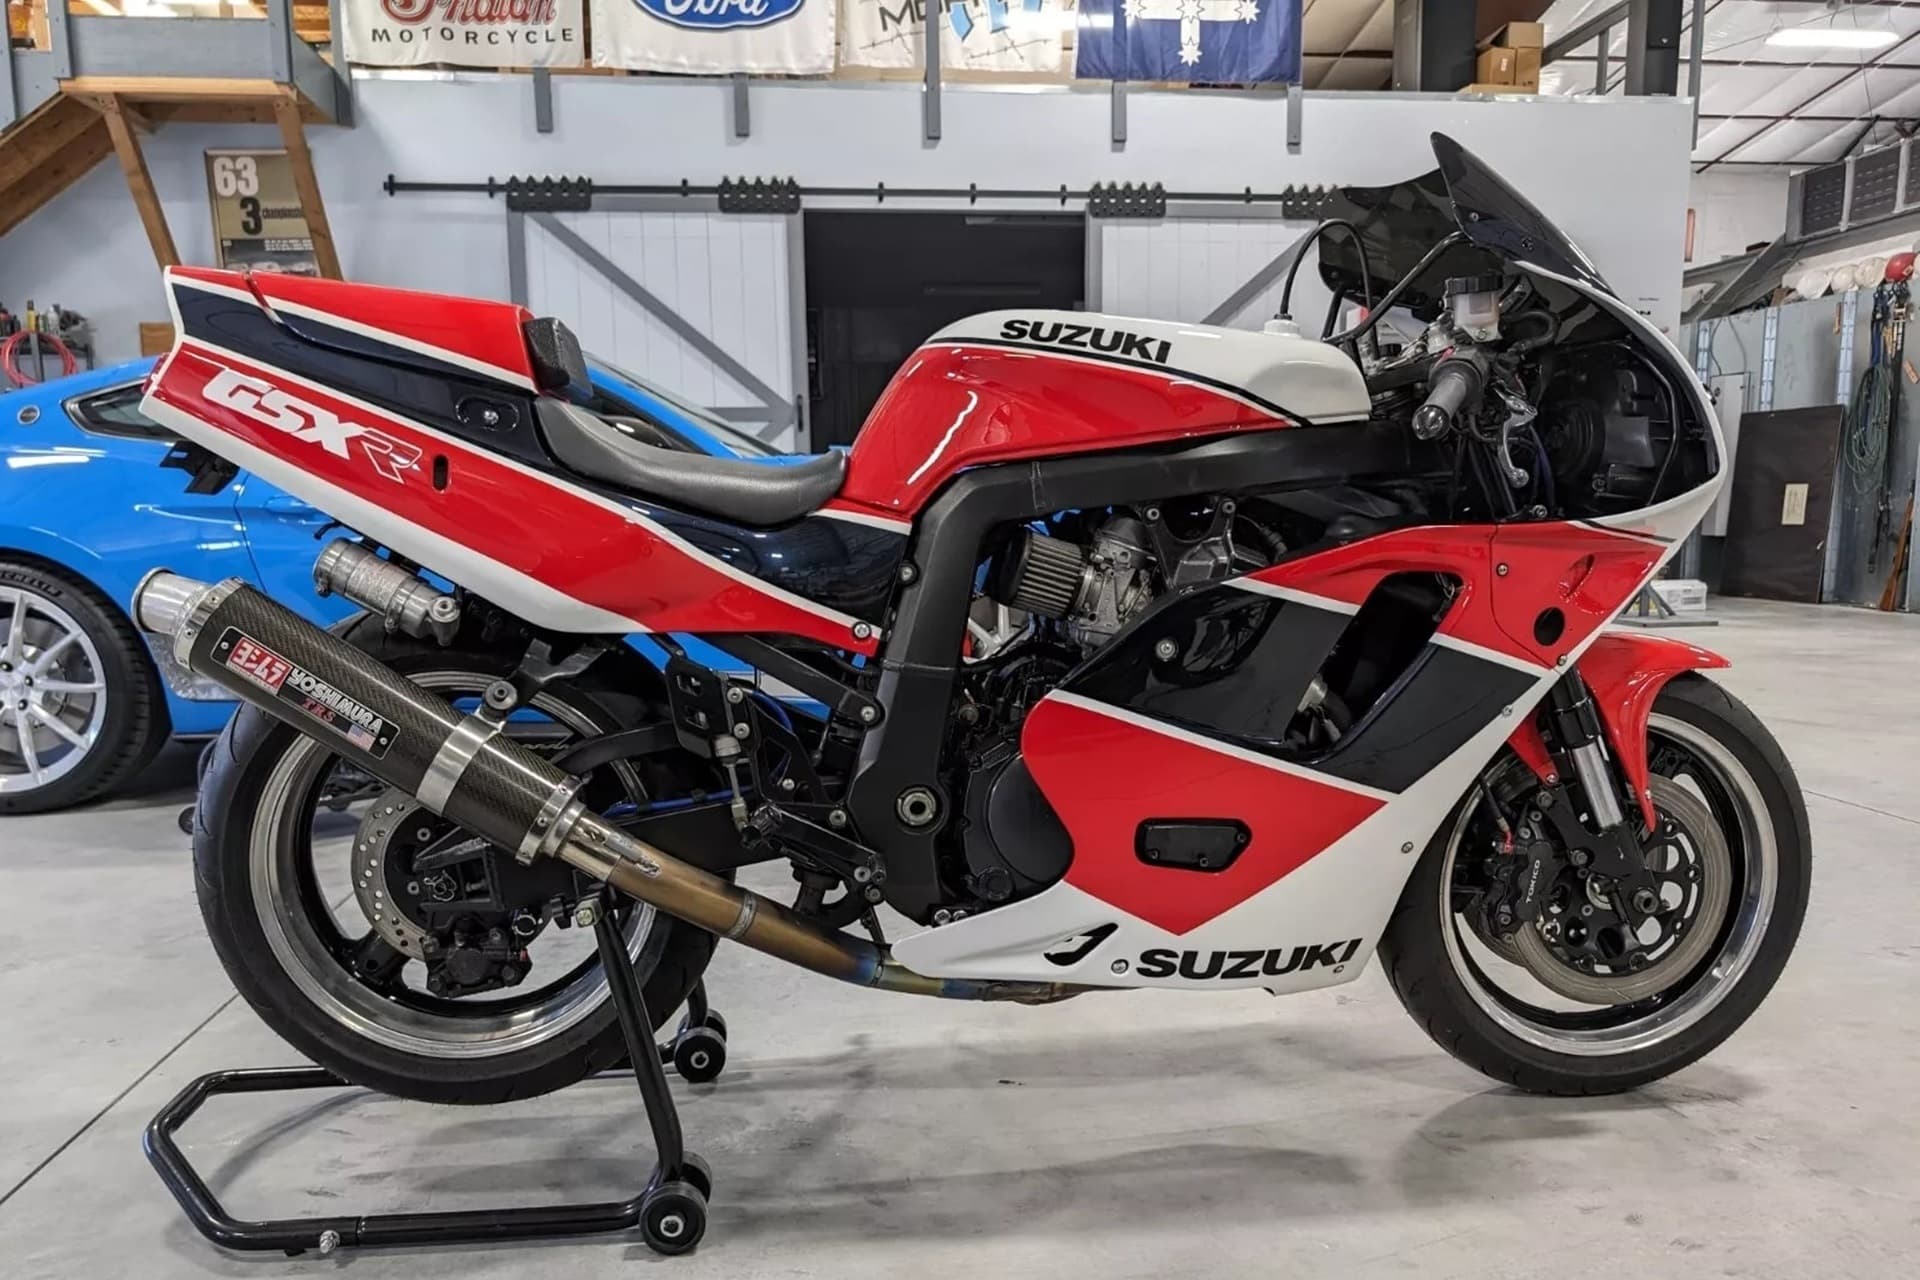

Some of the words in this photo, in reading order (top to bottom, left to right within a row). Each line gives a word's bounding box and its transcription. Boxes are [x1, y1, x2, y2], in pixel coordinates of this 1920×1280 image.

[371, 27, 574, 45] MOTORCYCLE
[214, 157, 259, 197] 63
[240, 197, 263, 236] 3
[1000, 320, 1172, 364] SUZUKI
[288, 668, 383, 735] YOSHIMURA
[302, 697, 337, 722] TRS
[1525, 860, 1541, 904] TOKICO
[1136, 938, 1363, 979] SUZUKI
